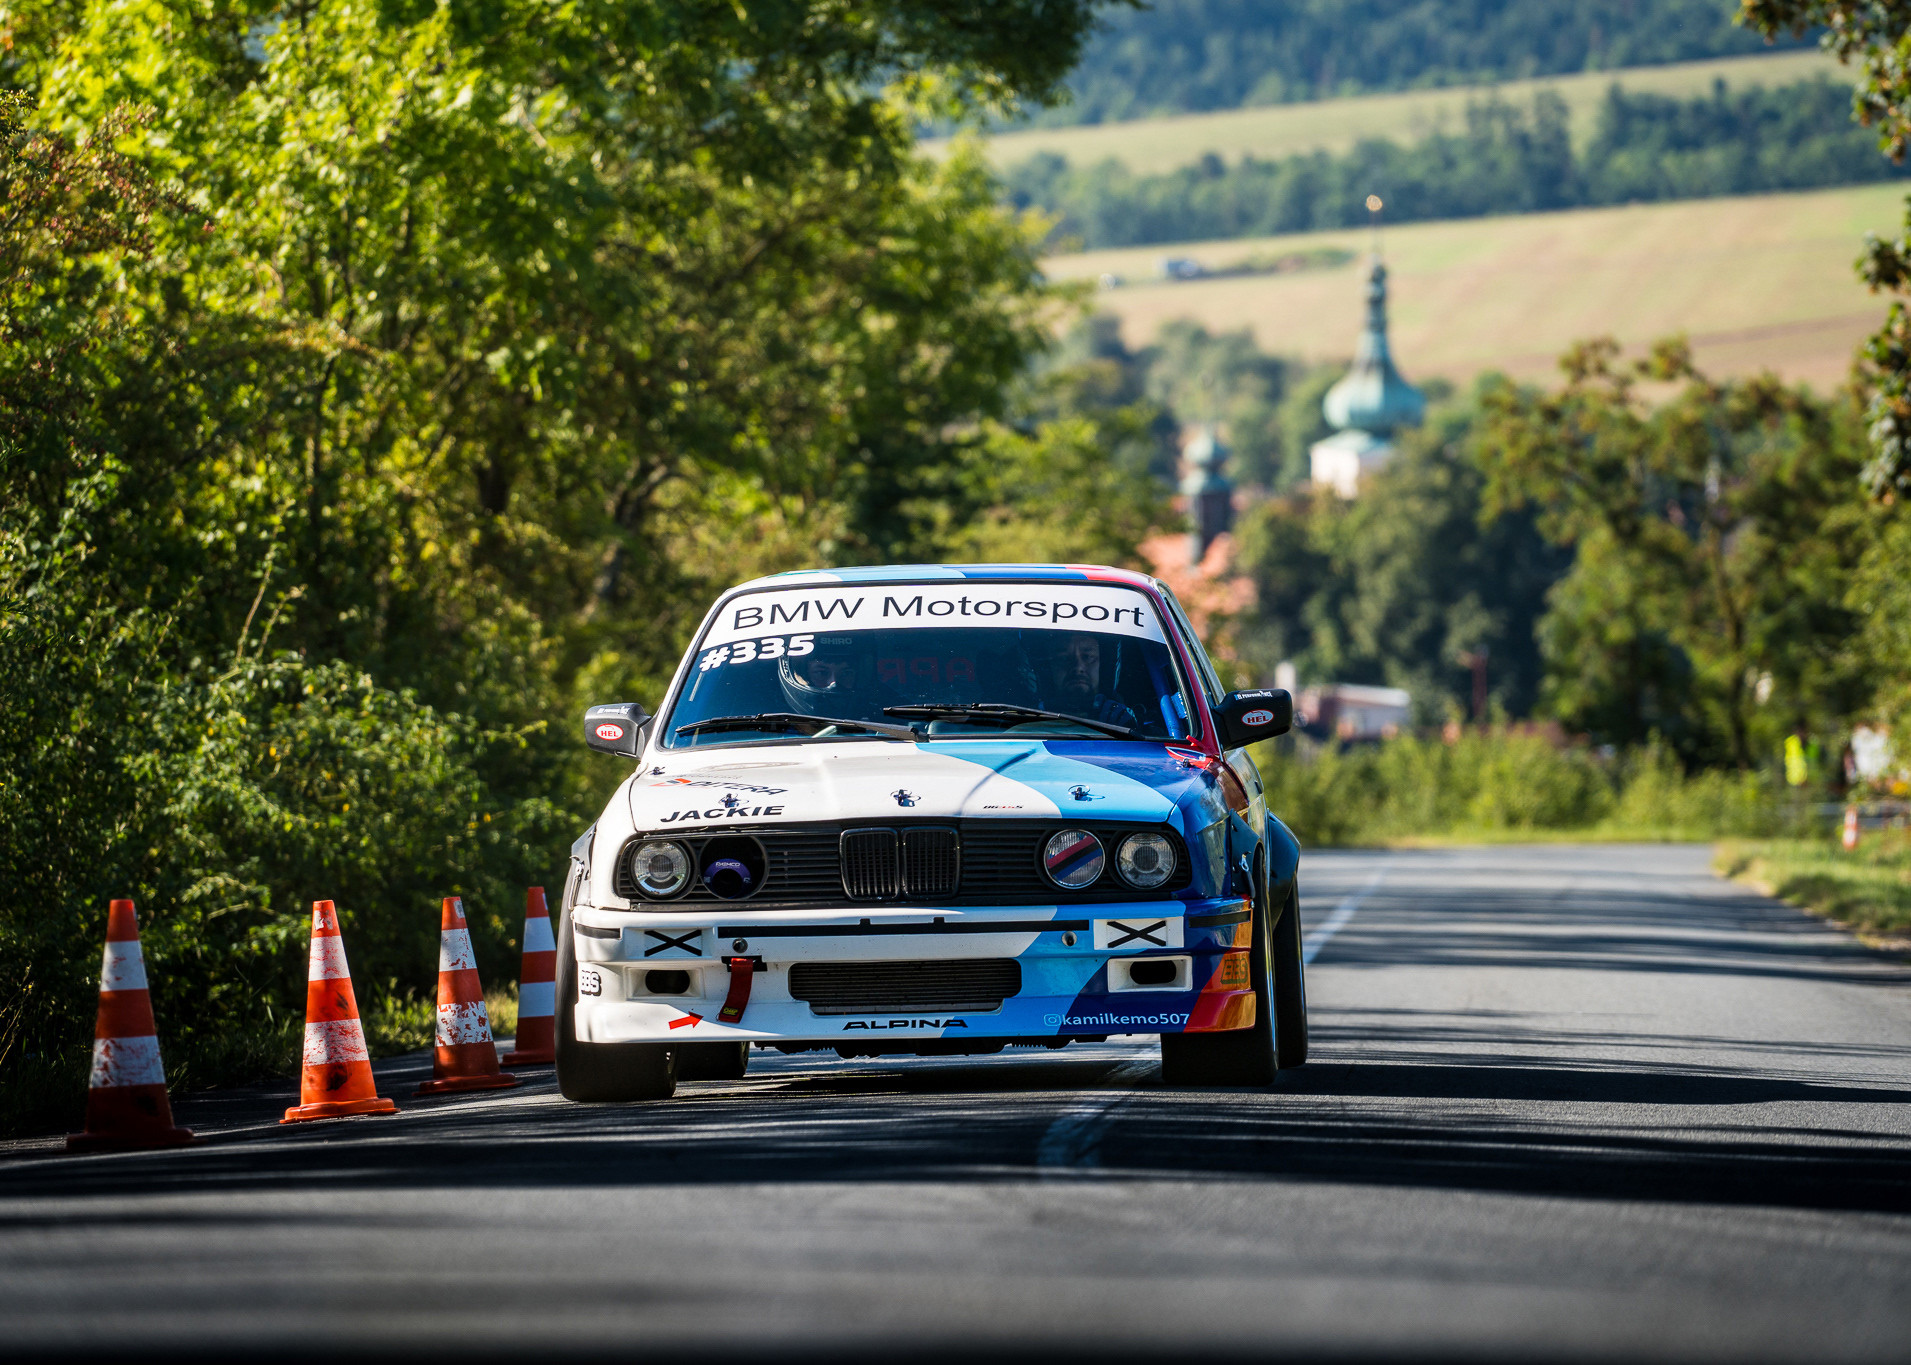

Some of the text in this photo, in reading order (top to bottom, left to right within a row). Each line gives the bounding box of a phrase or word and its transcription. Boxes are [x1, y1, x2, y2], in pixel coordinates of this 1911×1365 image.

[733, 595, 1145, 630] BMW Motorsport
[820, 637, 853, 645] SHIRO
[699, 634, 815, 672] #335
[1247, 715, 1269, 724] HEL
[660, 805, 785, 823] JACKIE
[1220, 958, 1248, 984] BBS
[581, 970, 602, 997] BBS
[843, 1018, 968, 1031] ALPINA
